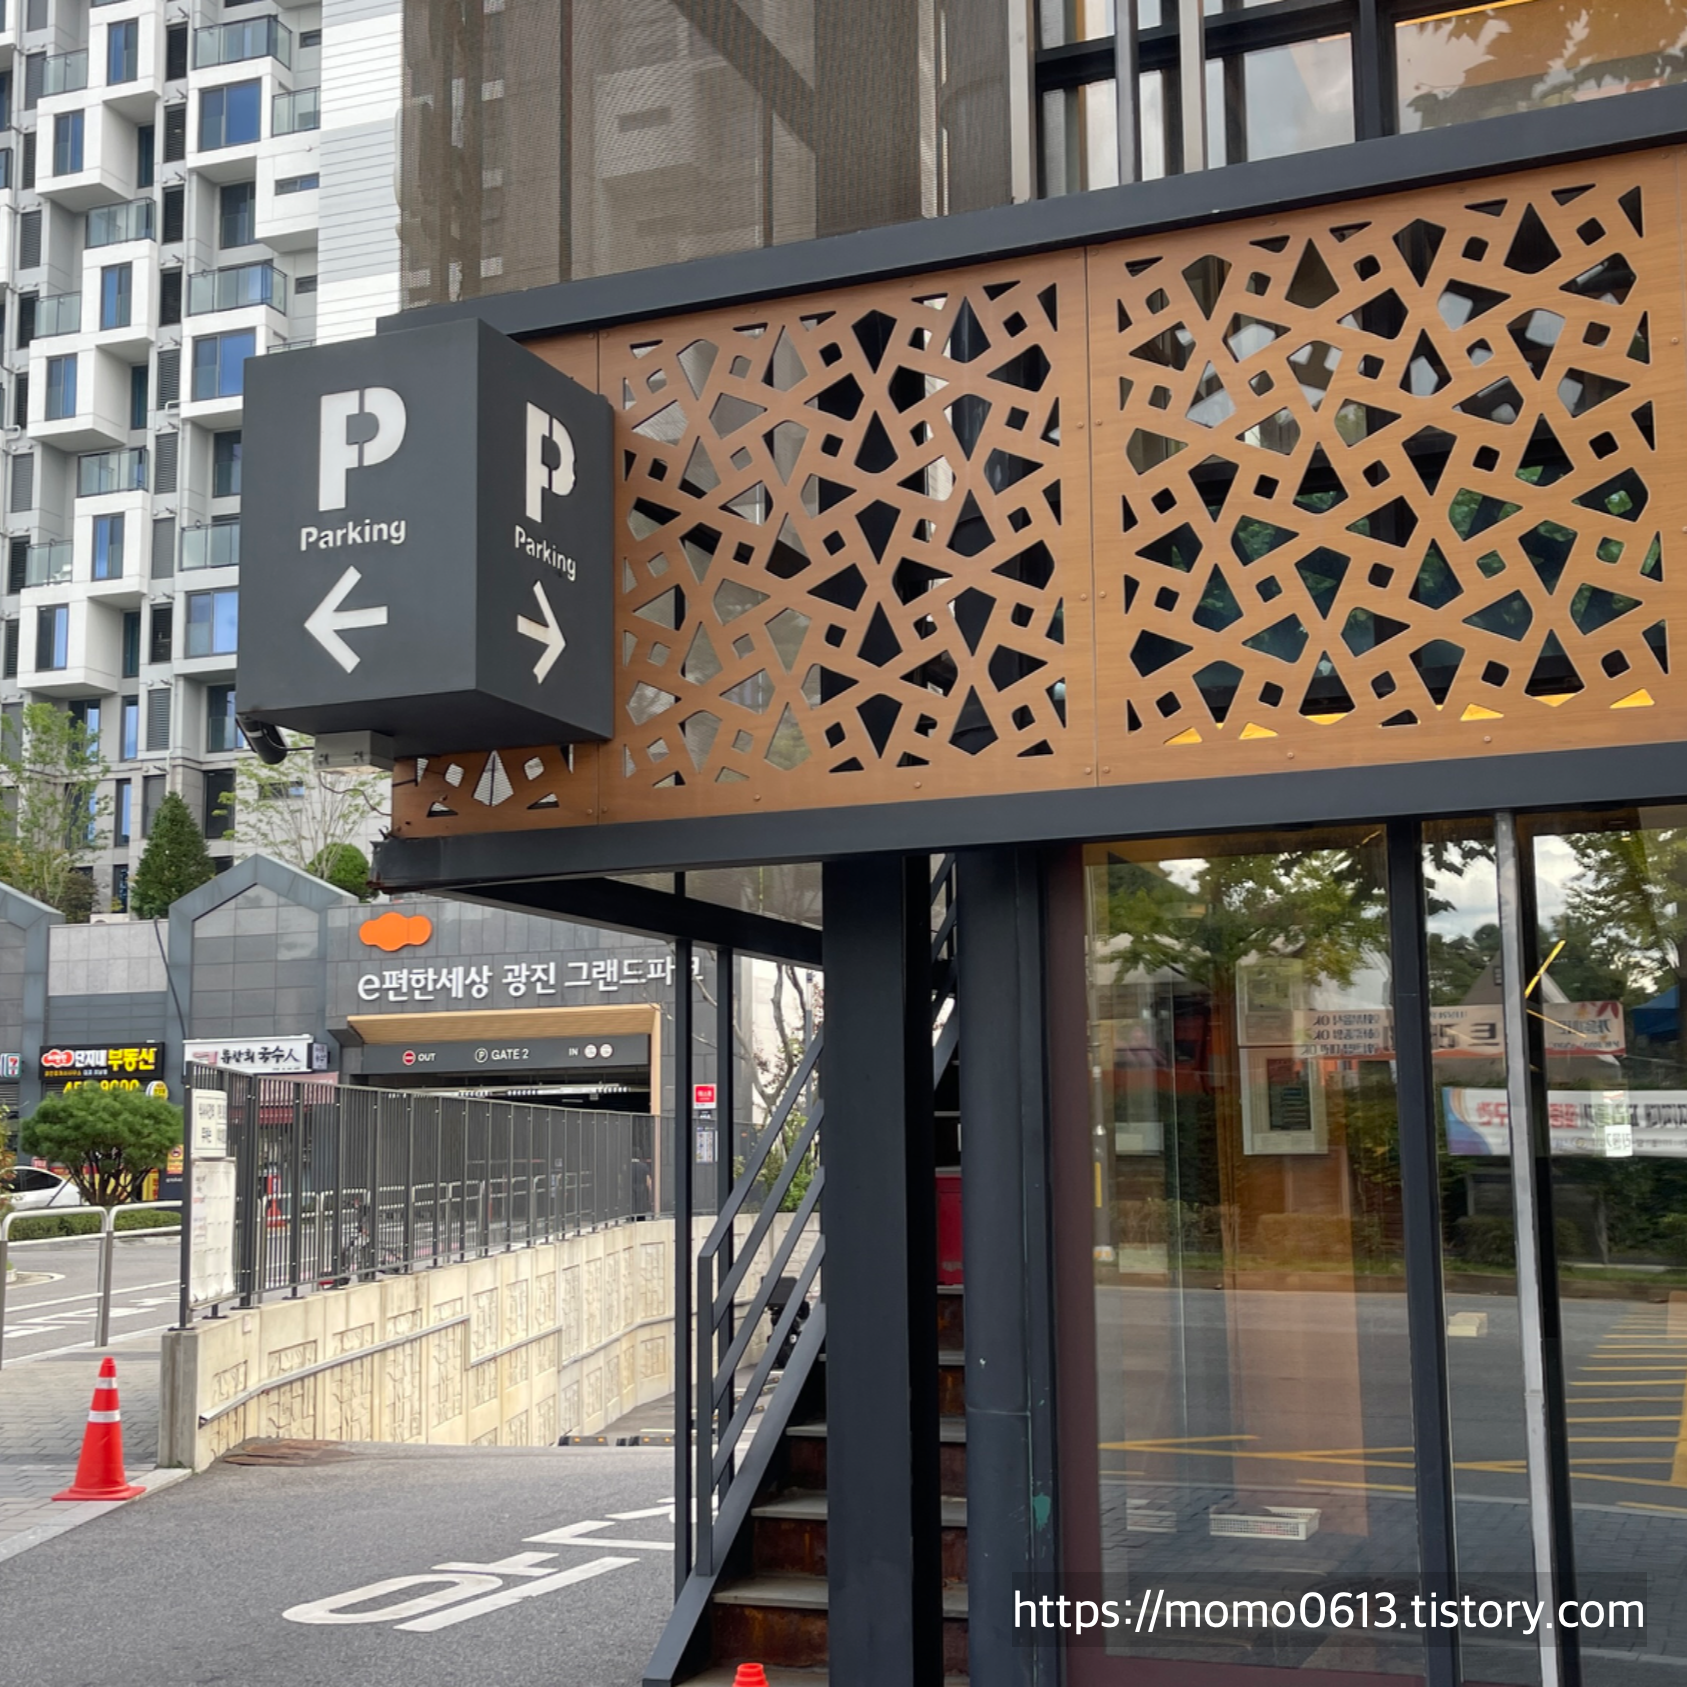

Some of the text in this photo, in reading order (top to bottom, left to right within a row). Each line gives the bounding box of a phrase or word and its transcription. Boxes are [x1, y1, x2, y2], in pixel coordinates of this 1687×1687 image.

[318, 386, 407, 512] P
[525, 400, 577, 523] P
[300, 518, 407, 551] Parking
[513, 524, 577, 582] Parking
[357, 965, 493, 1001] e편한세상
[502, 961, 556, 996] 광진
[107, 1047, 157, 1071] 부동산
[418, 1053, 436, 1062] OUT
[491, 1049, 519, 1061] GATE
[521, 1049, 529, 1060] 2
[568, 1047, 579, 1057] IN
